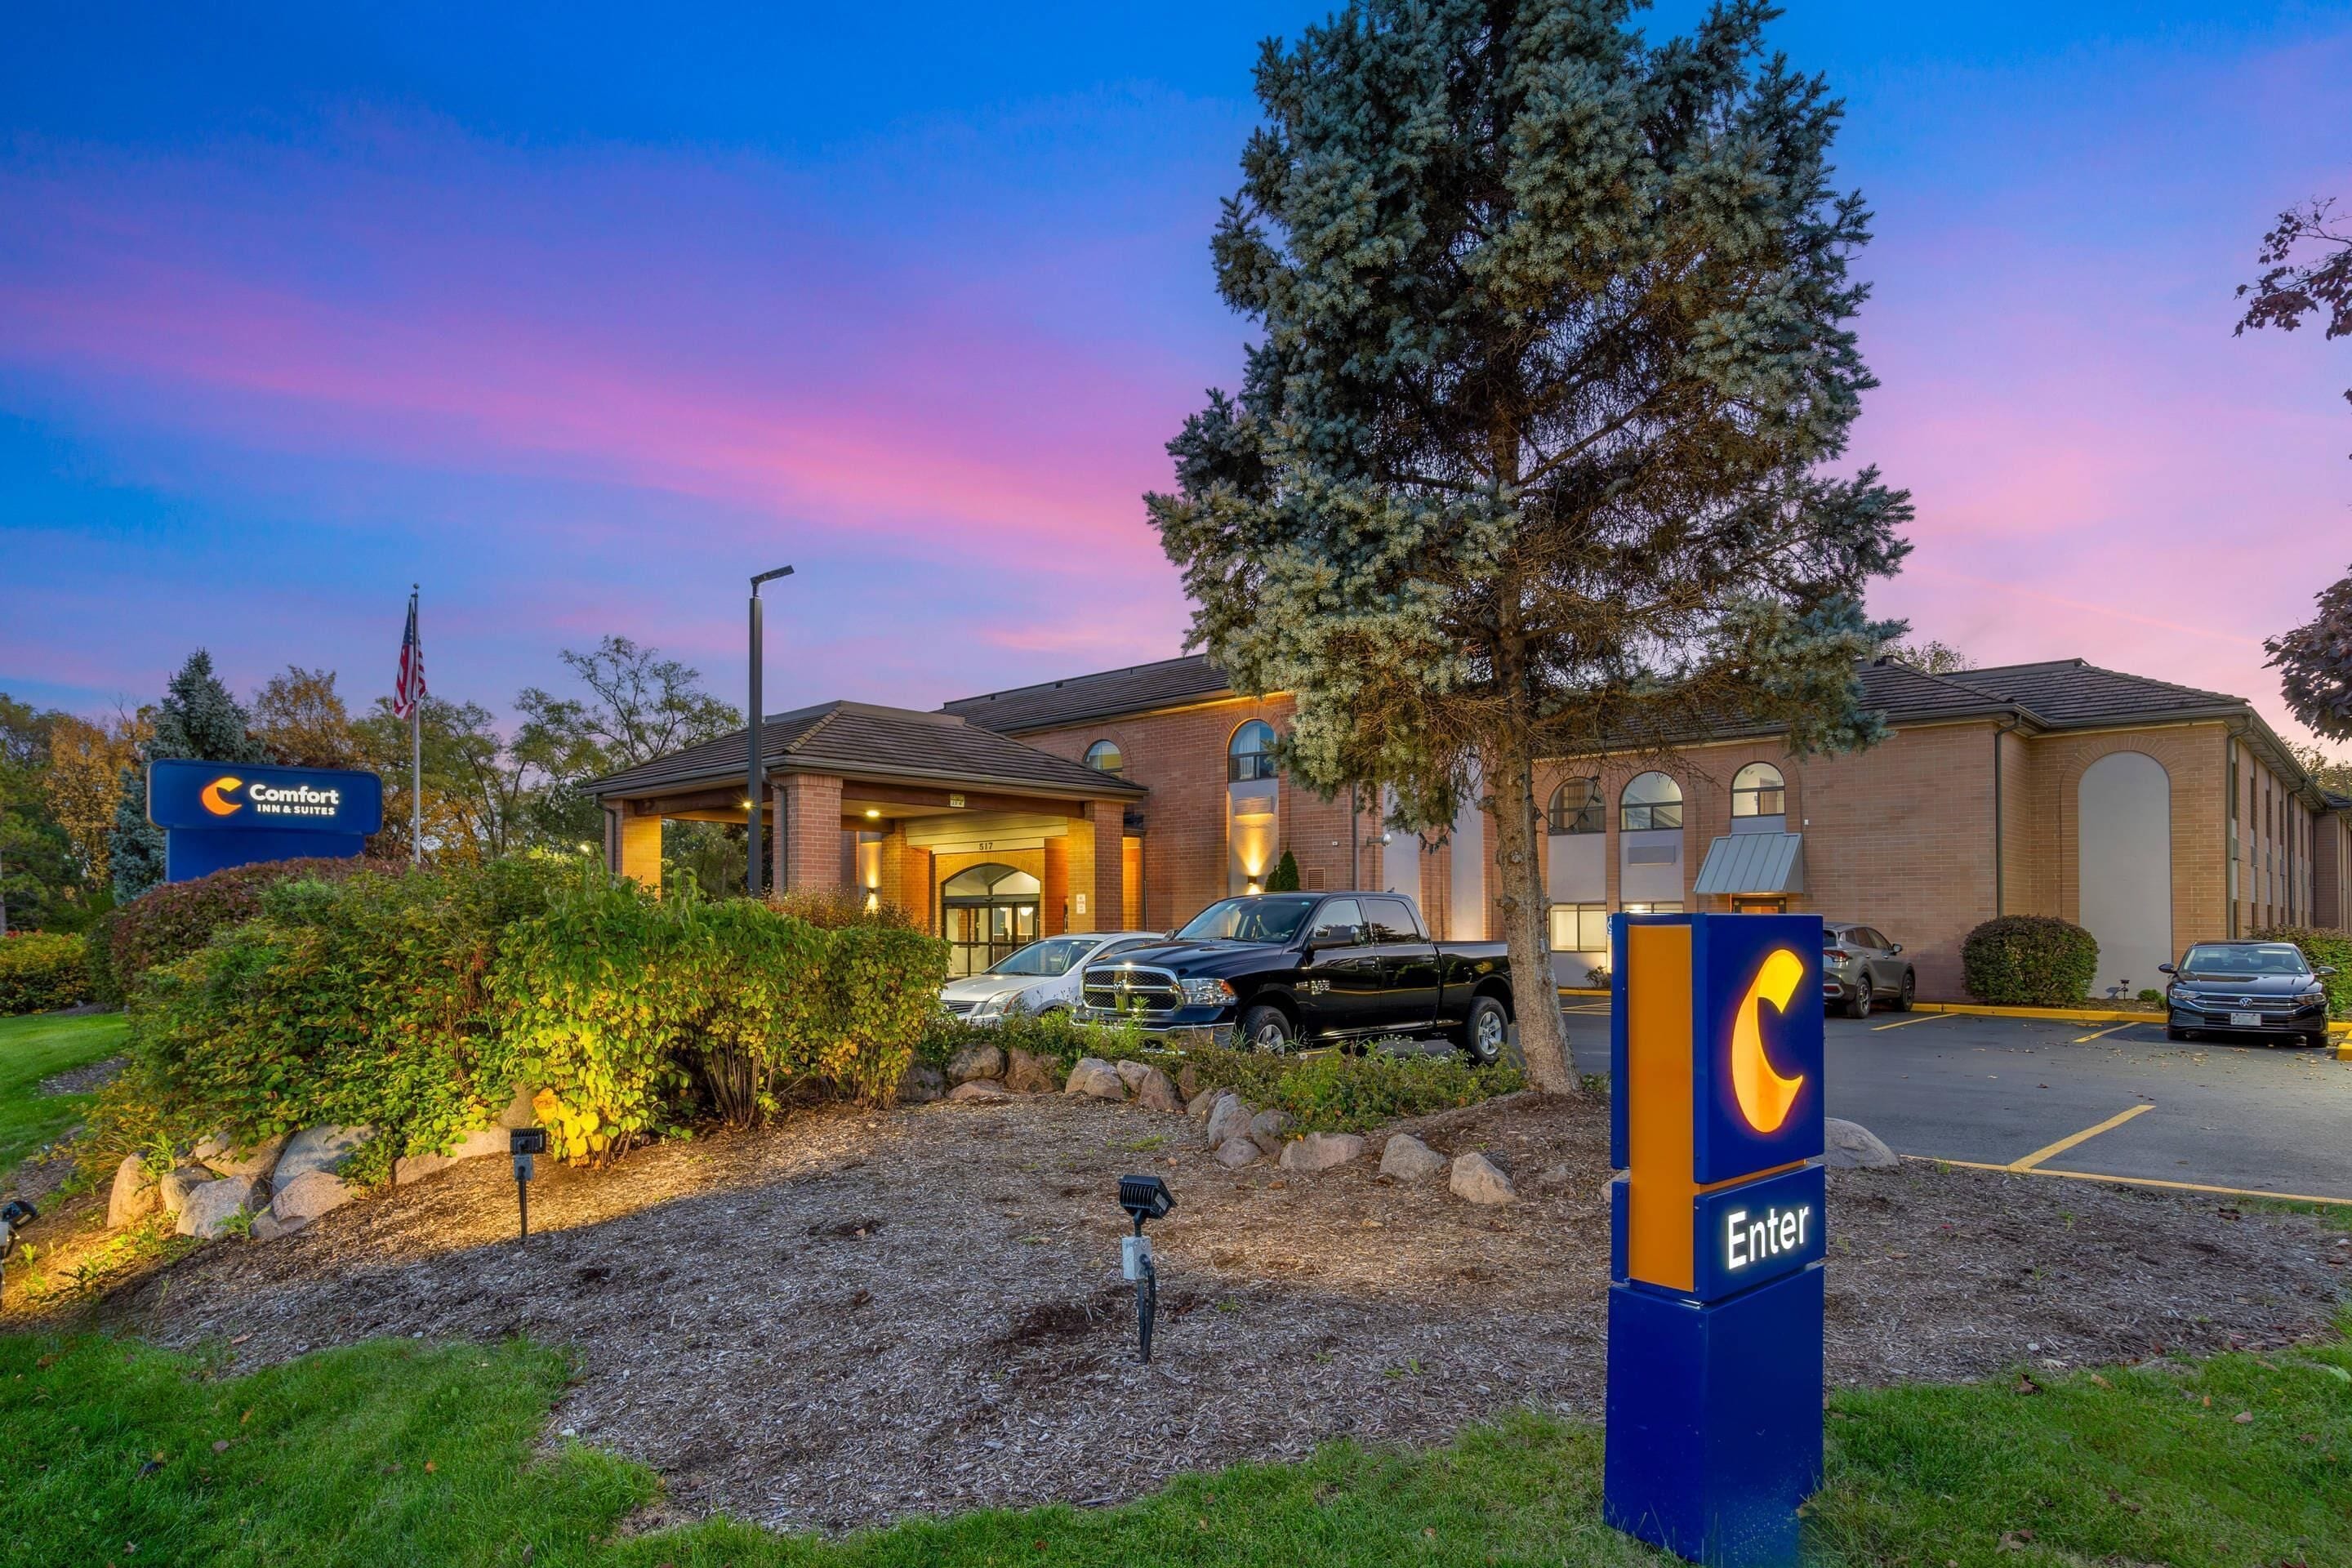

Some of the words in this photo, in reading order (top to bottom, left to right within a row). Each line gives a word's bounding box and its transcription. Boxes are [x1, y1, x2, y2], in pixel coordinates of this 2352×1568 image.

[250, 784, 339, 804] Comfort
[257, 804, 280, 813] INN
[283, 805, 292, 814] &
[294, 805, 335, 816] SUITES
[979, 842, 993, 851] 517
[1728, 1206, 1810, 1270] Enter
